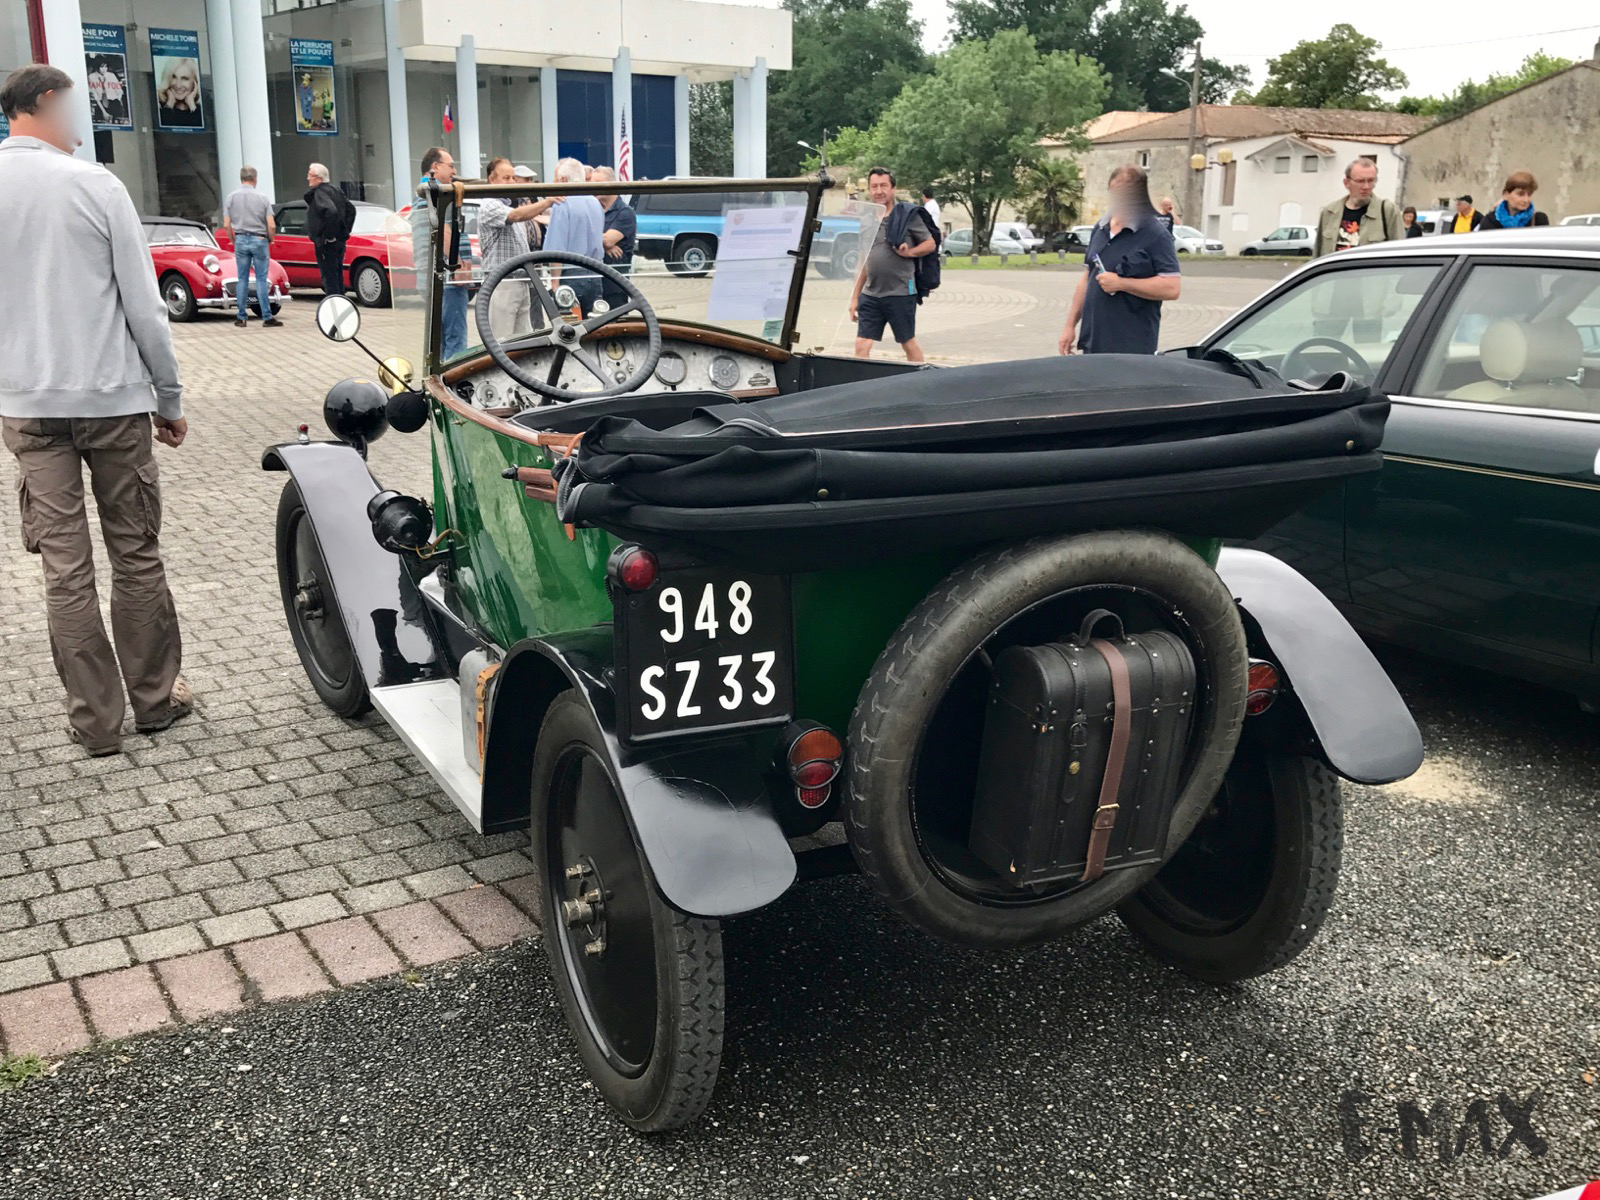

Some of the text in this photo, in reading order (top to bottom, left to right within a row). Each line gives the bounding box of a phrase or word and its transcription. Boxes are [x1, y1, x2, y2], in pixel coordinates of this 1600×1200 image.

[98, 29, 118, 37] FOLY
[299, 41, 332, 49] PERRUCHE
[307, 48, 332, 56] POULET
[658, 580, 753, 643] 948
[640, 651, 776, 721] SZ 33
